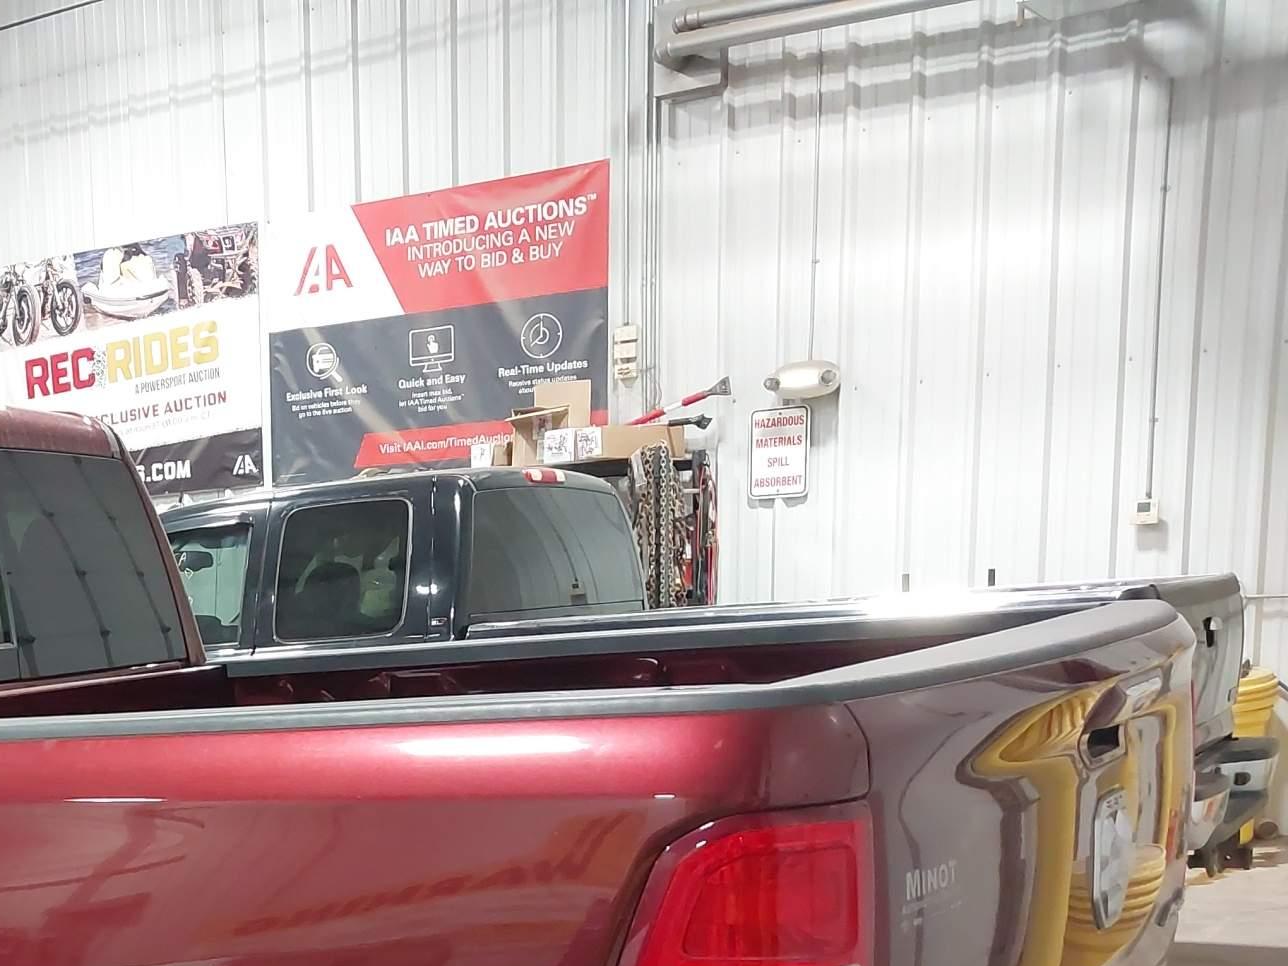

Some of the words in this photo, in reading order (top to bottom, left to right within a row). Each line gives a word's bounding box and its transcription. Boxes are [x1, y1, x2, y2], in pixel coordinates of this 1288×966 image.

[385, 226, 419, 248] IAA
[423, 215, 480, 241] TIMED
[407, 230, 513, 262] INTRODUCING
[517, 228, 531, 244] A
[536, 220, 575, 242] NEW
[417, 258, 452, 279] WAY
[455, 254, 476, 272] TO
[480, 247, 507, 268] BID
[511, 246, 525, 264] &
[529, 241, 564, 262] BUY
[24, 347, 95, 399] REC
[105, 320, 220, 385] RIDES
[498, 364, 545, 378] Real-Time
[546, 360, 588, 373] Updates
[140, 373, 186, 393] POWERSPORT
[188, 367, 221, 383] AUCTION
[398, 377, 425, 389] Quick
[426, 375, 443, 386] and
[445, 373, 466, 384] Easy
[286, 389, 323, 402] Exclusive
[324, 387, 343, 398] First
[345, 384, 368, 395] Look
[164, 391, 227, 414] AUCTION
[754, 414, 805, 429] HAZARDOUS
[379, 441, 402, 454] Visit
[755, 434, 803, 449] MATERIALS
[767, 455, 790, 468] SPILL
[753, 474, 803, 489] ABSORBENT
[905, 860, 958, 901] MINOT
